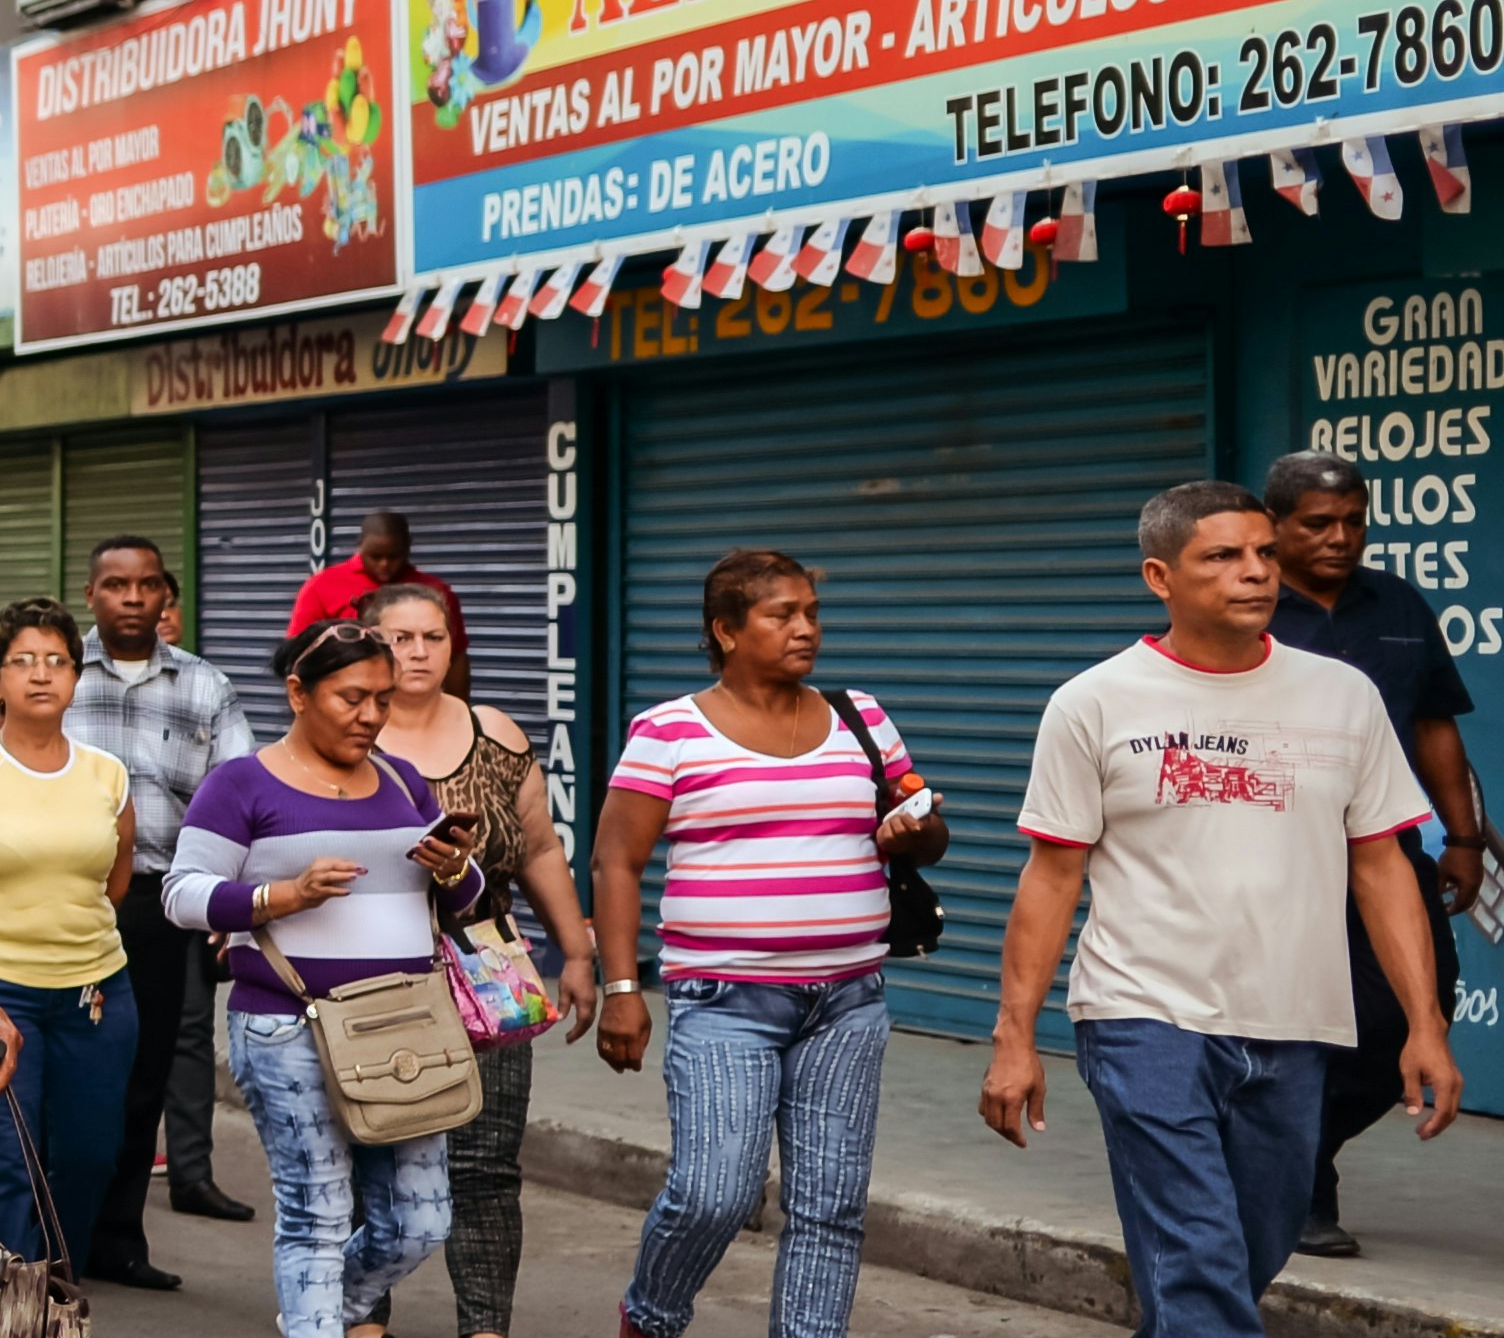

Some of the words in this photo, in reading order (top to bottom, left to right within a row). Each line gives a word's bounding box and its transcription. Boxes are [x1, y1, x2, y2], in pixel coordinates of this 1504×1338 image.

[38, 1, 246, 121] DISTRIBUIDORA
[470, 78, 590, 156] VENTAS
[597, 67, 641, 128] AL
[651, 46, 724, 116] POR
[733, 10, 871, 97] MAYOR
[946, 50, 1221, 161] TELEFONO:
[25, 147, 69, 189] VENTAS
[71, 144, 85, 178] AL
[88, 139, 114, 176] POR
[115, 125, 159, 170] MAYOR
[482, 172, 638, 242] PRENDAS:
[648, 154, 694, 213] DE
[703, 130, 830, 205] ACERO
[90, 190, 115, 228] ORO
[117, 172, 194, 221] ENCHAPADO
[168, 226, 203, 268] PARA
[206, 203, 303, 259] CUMPLEAÑOS
[158, 263, 261, 317] 262-5388
[1363, 287, 1484, 346] GRAN
[147, 325, 357, 407] Distribuidora
[1311, 405, 1491, 463] RELOJES
[1129, 731, 1189, 755] DYLAN
[1194, 734, 1249, 755] JEANS
